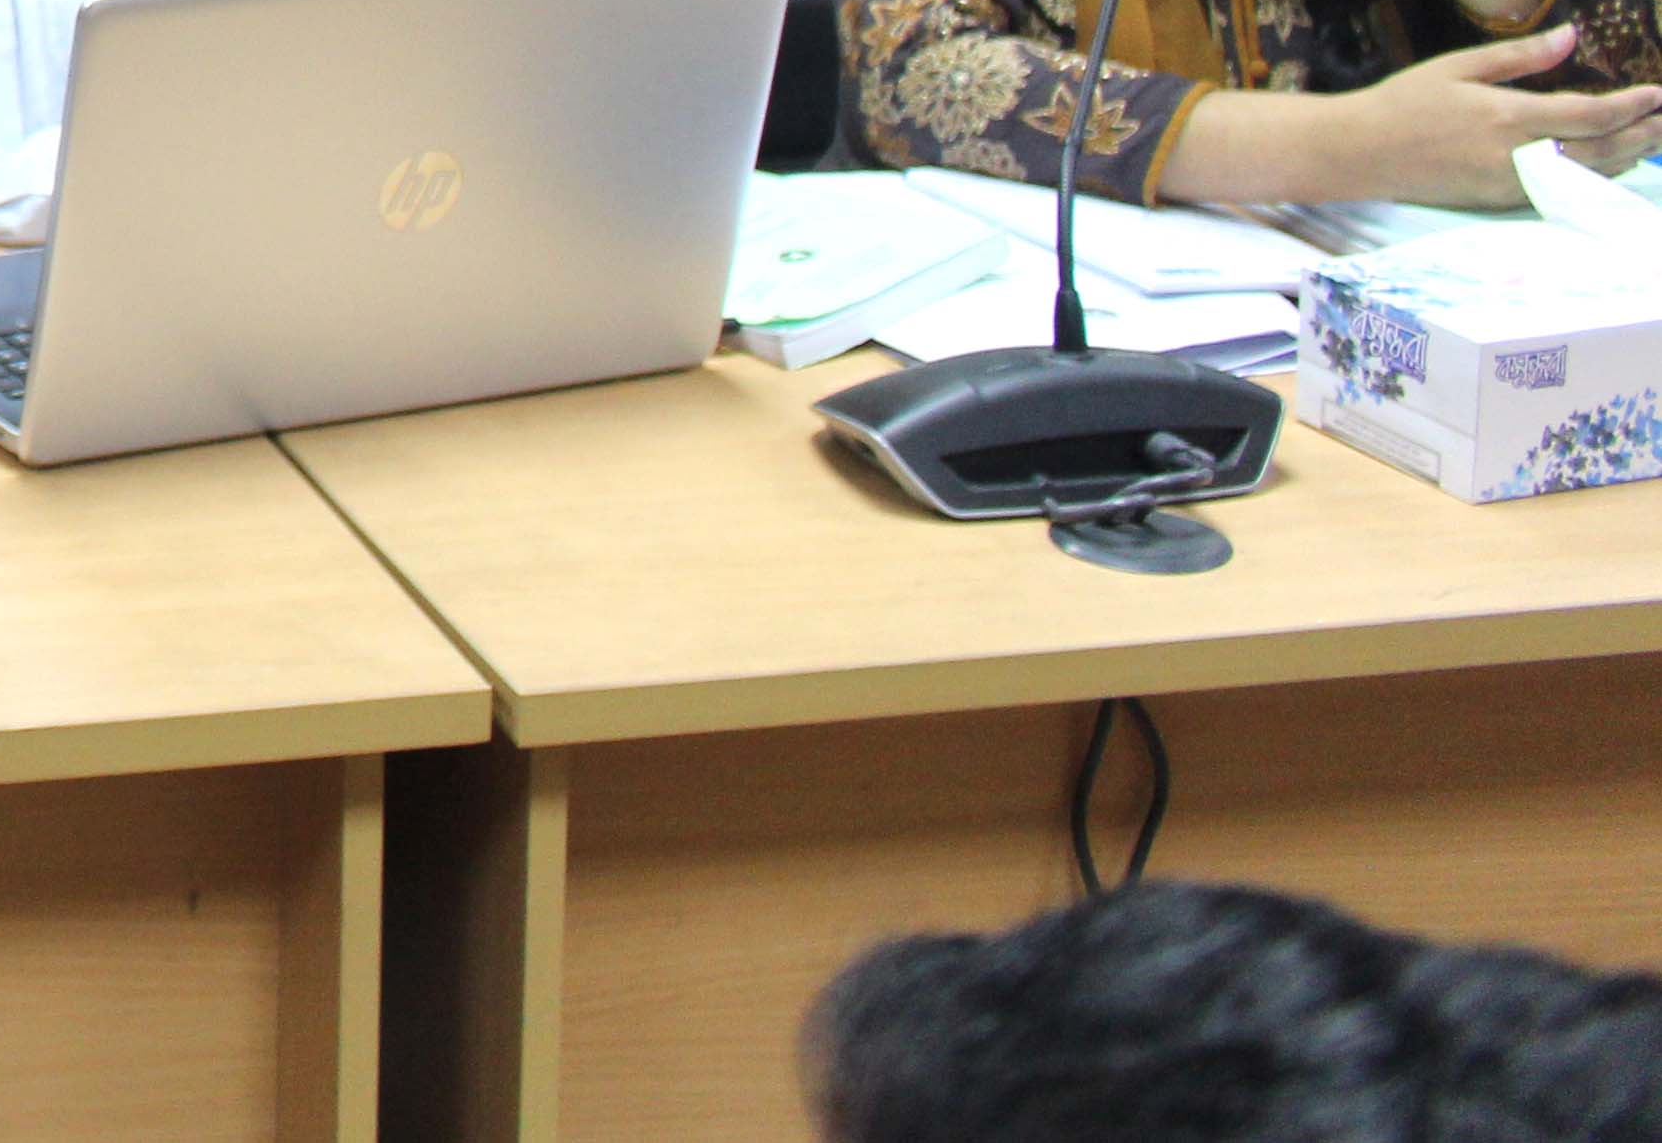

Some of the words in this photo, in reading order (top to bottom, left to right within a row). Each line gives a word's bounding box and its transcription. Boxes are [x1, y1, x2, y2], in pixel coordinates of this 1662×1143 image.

[382, 154, 460, 232] hp
[1350, 306, 1430, 381] বসুন্ধরা
[1495, 345, 1567, 391] বসুন্ধরা
